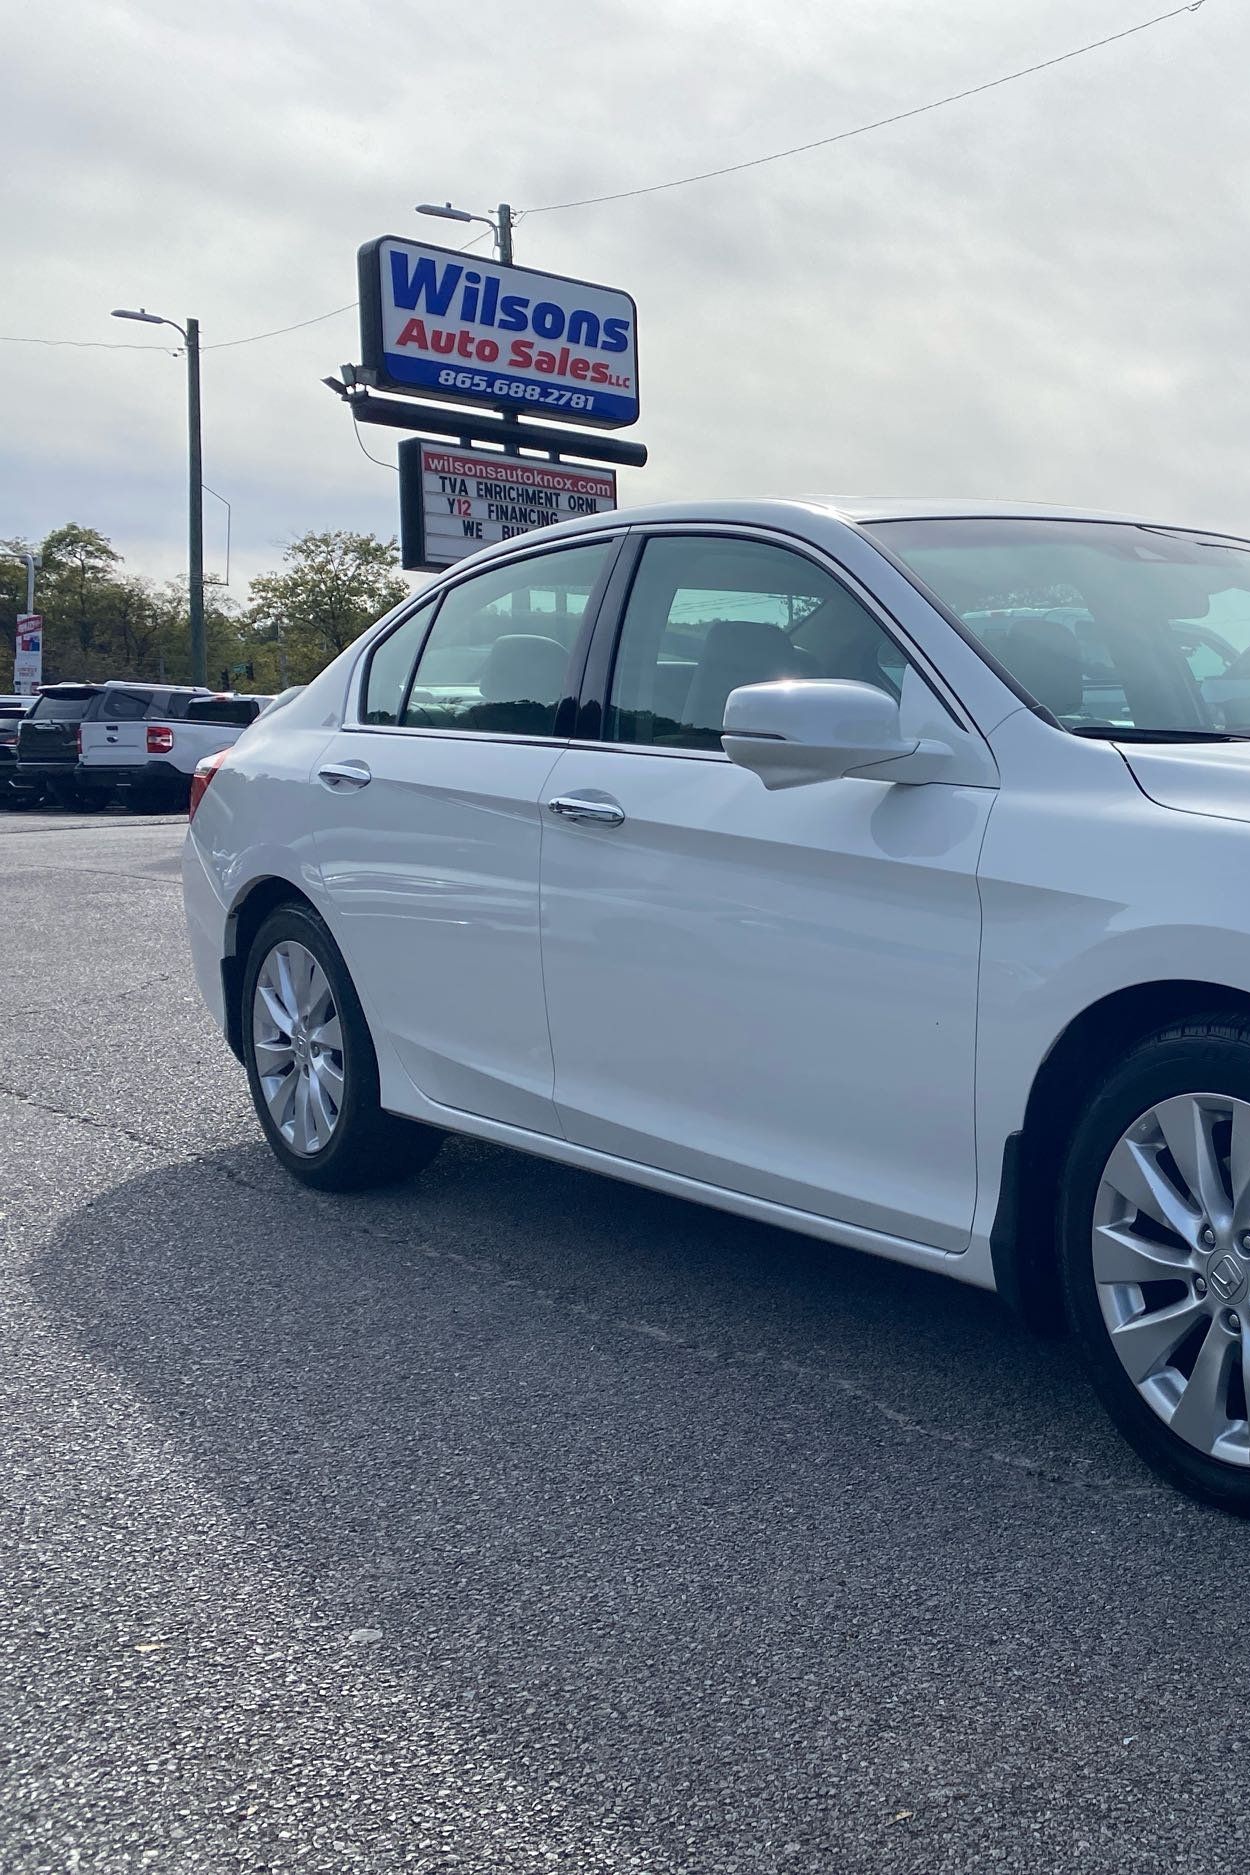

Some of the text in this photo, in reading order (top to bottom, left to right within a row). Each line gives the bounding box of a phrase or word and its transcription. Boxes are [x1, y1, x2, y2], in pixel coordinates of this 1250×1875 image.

[389, 250, 630, 353] Wilsons
[396, 318, 630, 389] Auto Sales LLC
[438, 370, 595, 411] 865.688.2781
[428, 456, 611, 497] wilsonsautoknox.com
[439, 476, 600, 514] TVA ENRICHMENT ORNL
[447, 498, 559, 527] Y12 FINANCING
[462, 520, 483, 539] WE
